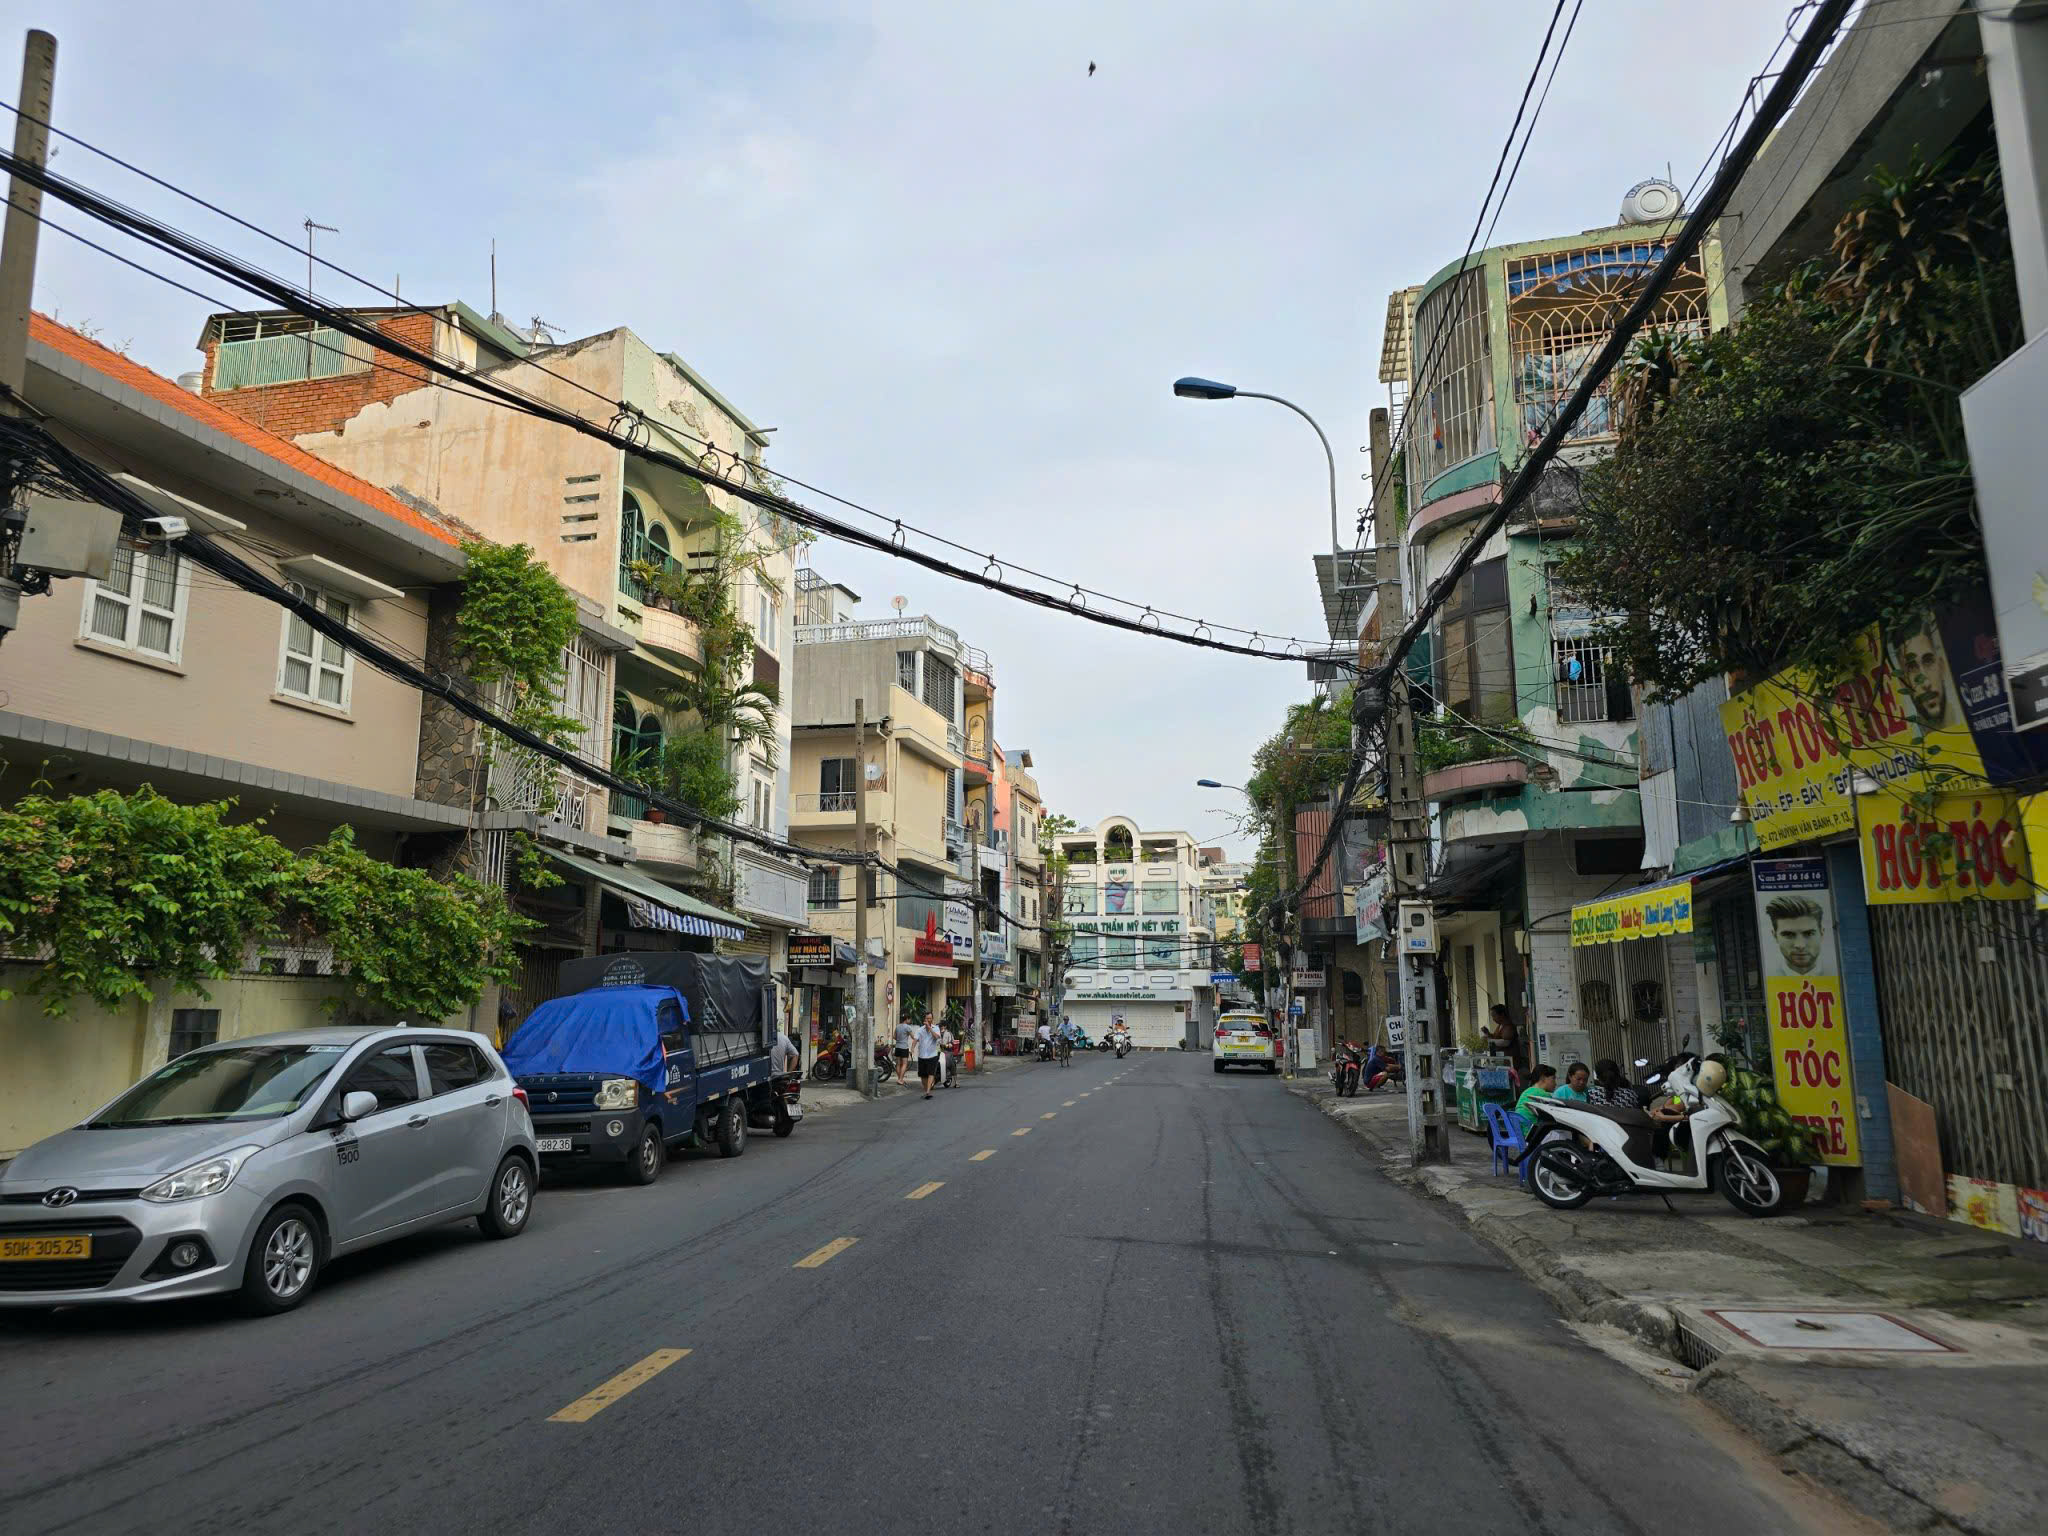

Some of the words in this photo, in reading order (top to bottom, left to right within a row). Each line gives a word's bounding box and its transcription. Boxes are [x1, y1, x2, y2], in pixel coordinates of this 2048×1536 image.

[1789, 873, 1797, 881] 16
[1812, 872, 1821, 880] 16
[1077, 922, 1098, 932] KHOA
[1127, 919, 1139, 931] MỸ
[1142, 920, 1158, 932] NÉT
[1161, 920, 1179, 933] VIỆT
[1777, 980, 1835, 1029] HỚT
[1784, 1039, 1841, 1088] TÓC
[337, 1149, 359, 1166] 1900
